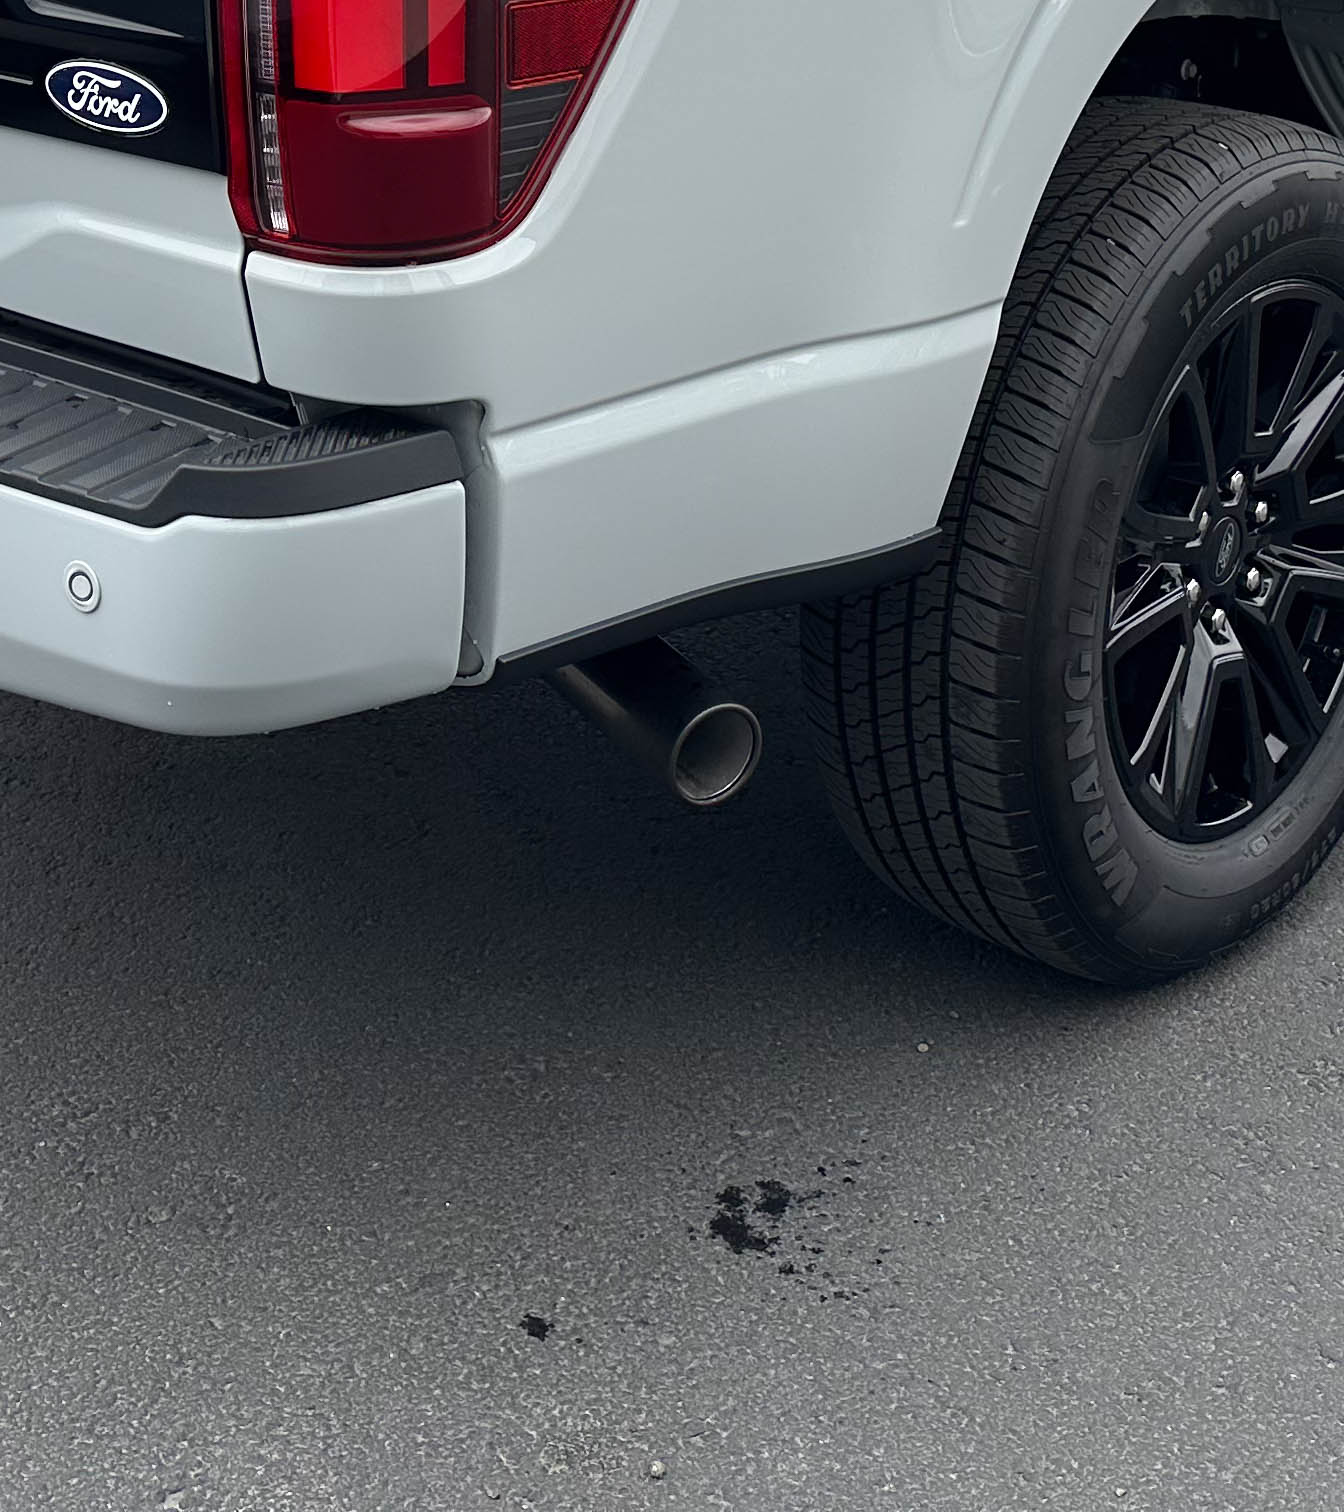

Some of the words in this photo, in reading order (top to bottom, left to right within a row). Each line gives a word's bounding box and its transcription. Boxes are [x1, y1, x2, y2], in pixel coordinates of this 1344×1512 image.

[67, 70, 142, 123] Ford
[1178, 202, 1311, 329] TERRITORY
[1063, 477, 1139, 907] WRANGLER
